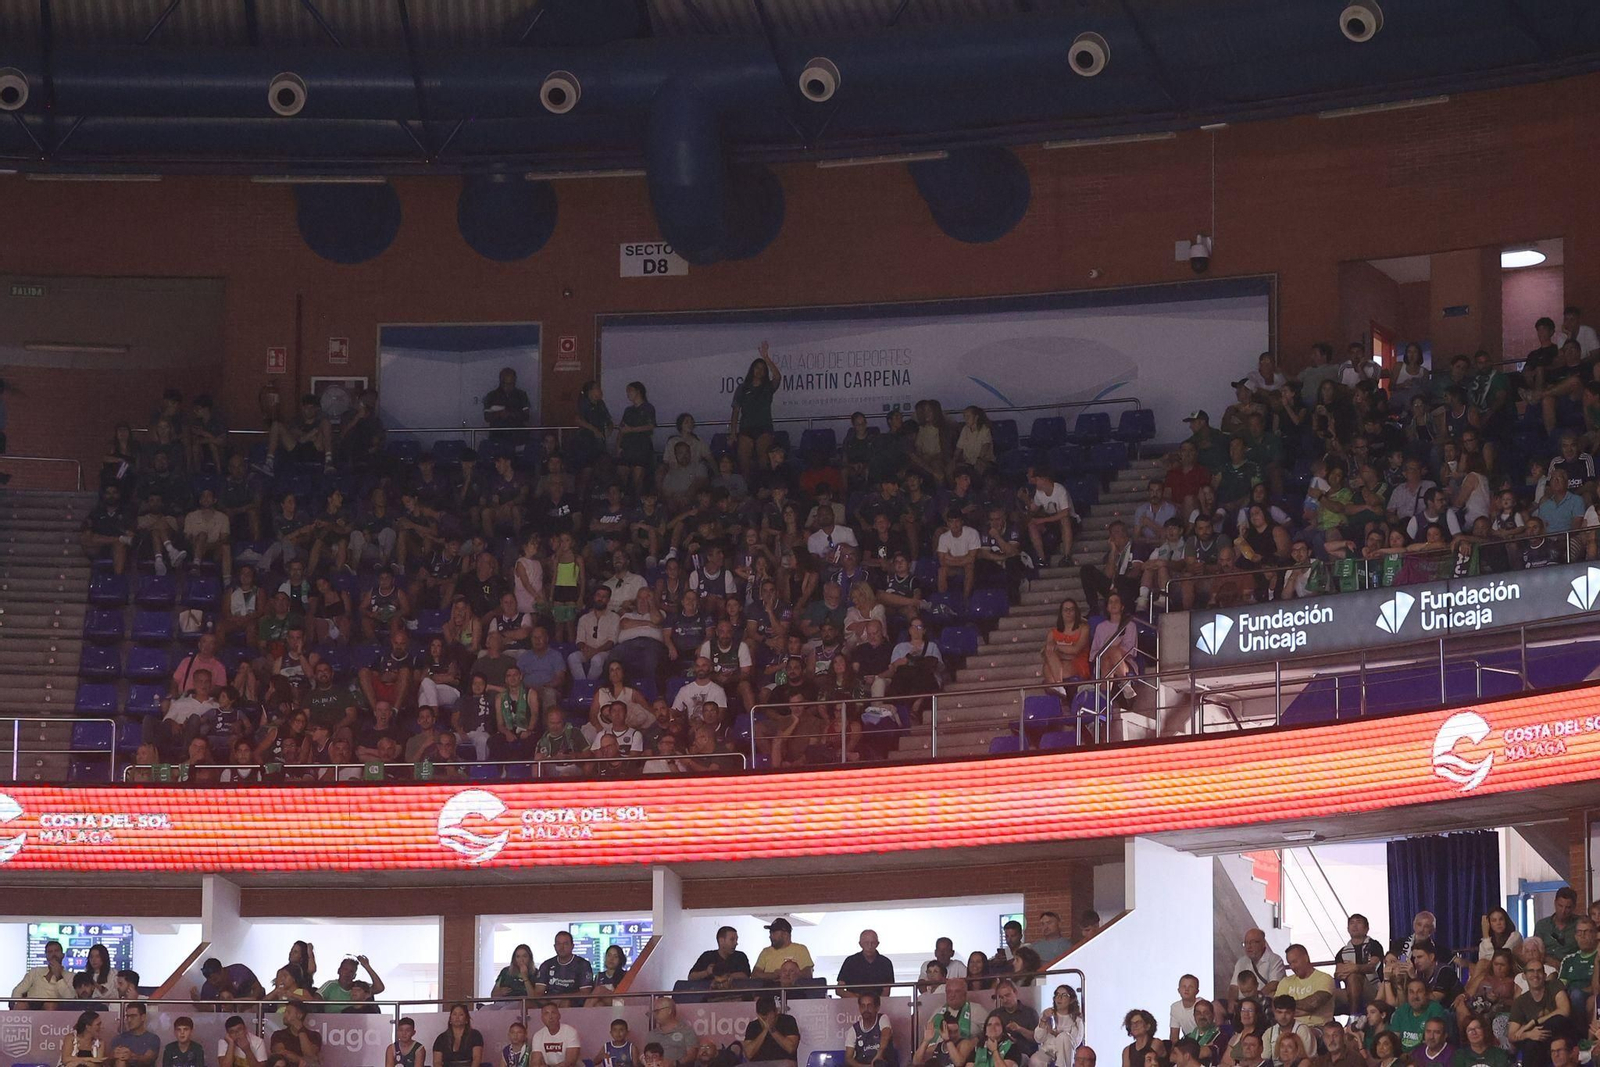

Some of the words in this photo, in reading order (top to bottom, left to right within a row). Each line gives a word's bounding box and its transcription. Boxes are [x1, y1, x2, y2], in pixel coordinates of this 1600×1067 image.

[625, 244, 674, 256] SECTO
[643, 259, 669, 275] D8
[12, 286, 43, 296] SALIDA
[773, 352, 825, 371] PALACIO
[829, 351, 845, 369] DE
[848, 348, 912, 368] DEPORTES
[719, 376, 745, 394] JOS
[782, 370, 838, 391] MARTÍN
[844, 369, 911, 389] CARPENA
[1421, 580, 1520, 610] Fundación
[1239, 604, 1333, 633] Fundación
[1421, 605, 1493, 631] Unicaja
[1239, 628, 1307, 653] Unicaja
[1504, 724, 1552, 743] COSTA
[1555, 719, 1581, 737] DEL
[41, 813, 97, 828] COSTA
[100, 814, 135, 828] DEL
[138, 814, 171, 828] SOL
[522, 809, 577, 823] COSTA
[581, 808, 613, 822] DEL
[616, 806, 648, 821] SOL
[628, 924, 639, 934] 43
[40, 1024, 74, 1036] Ciud
[309, 1019, 382, 1053] laga
[39, 1039, 56, 1051] de
